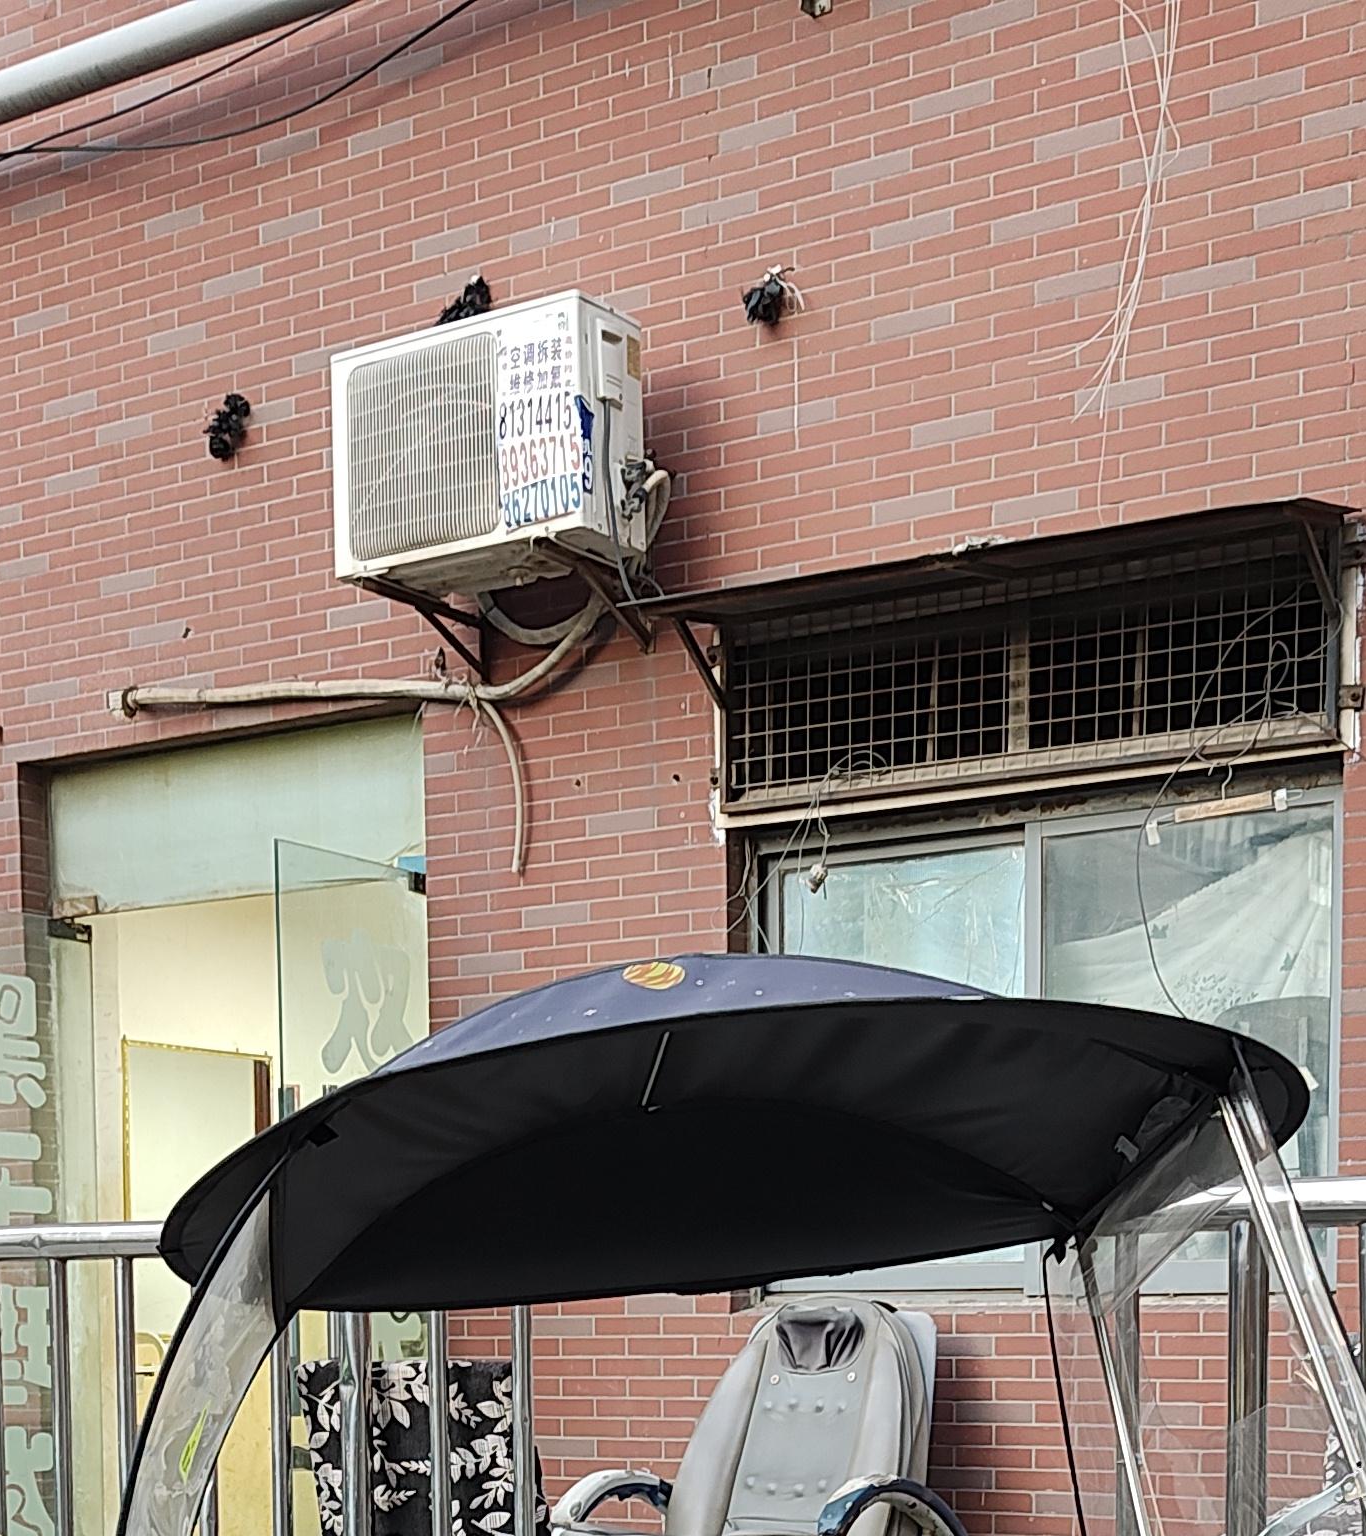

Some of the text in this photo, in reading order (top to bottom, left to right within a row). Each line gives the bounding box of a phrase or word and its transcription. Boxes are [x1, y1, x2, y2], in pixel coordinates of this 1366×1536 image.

[499, 390, 572, 440] 81314415
[501, 426, 581, 492] 89363715
[502, 472, 581, 529] 86270105
